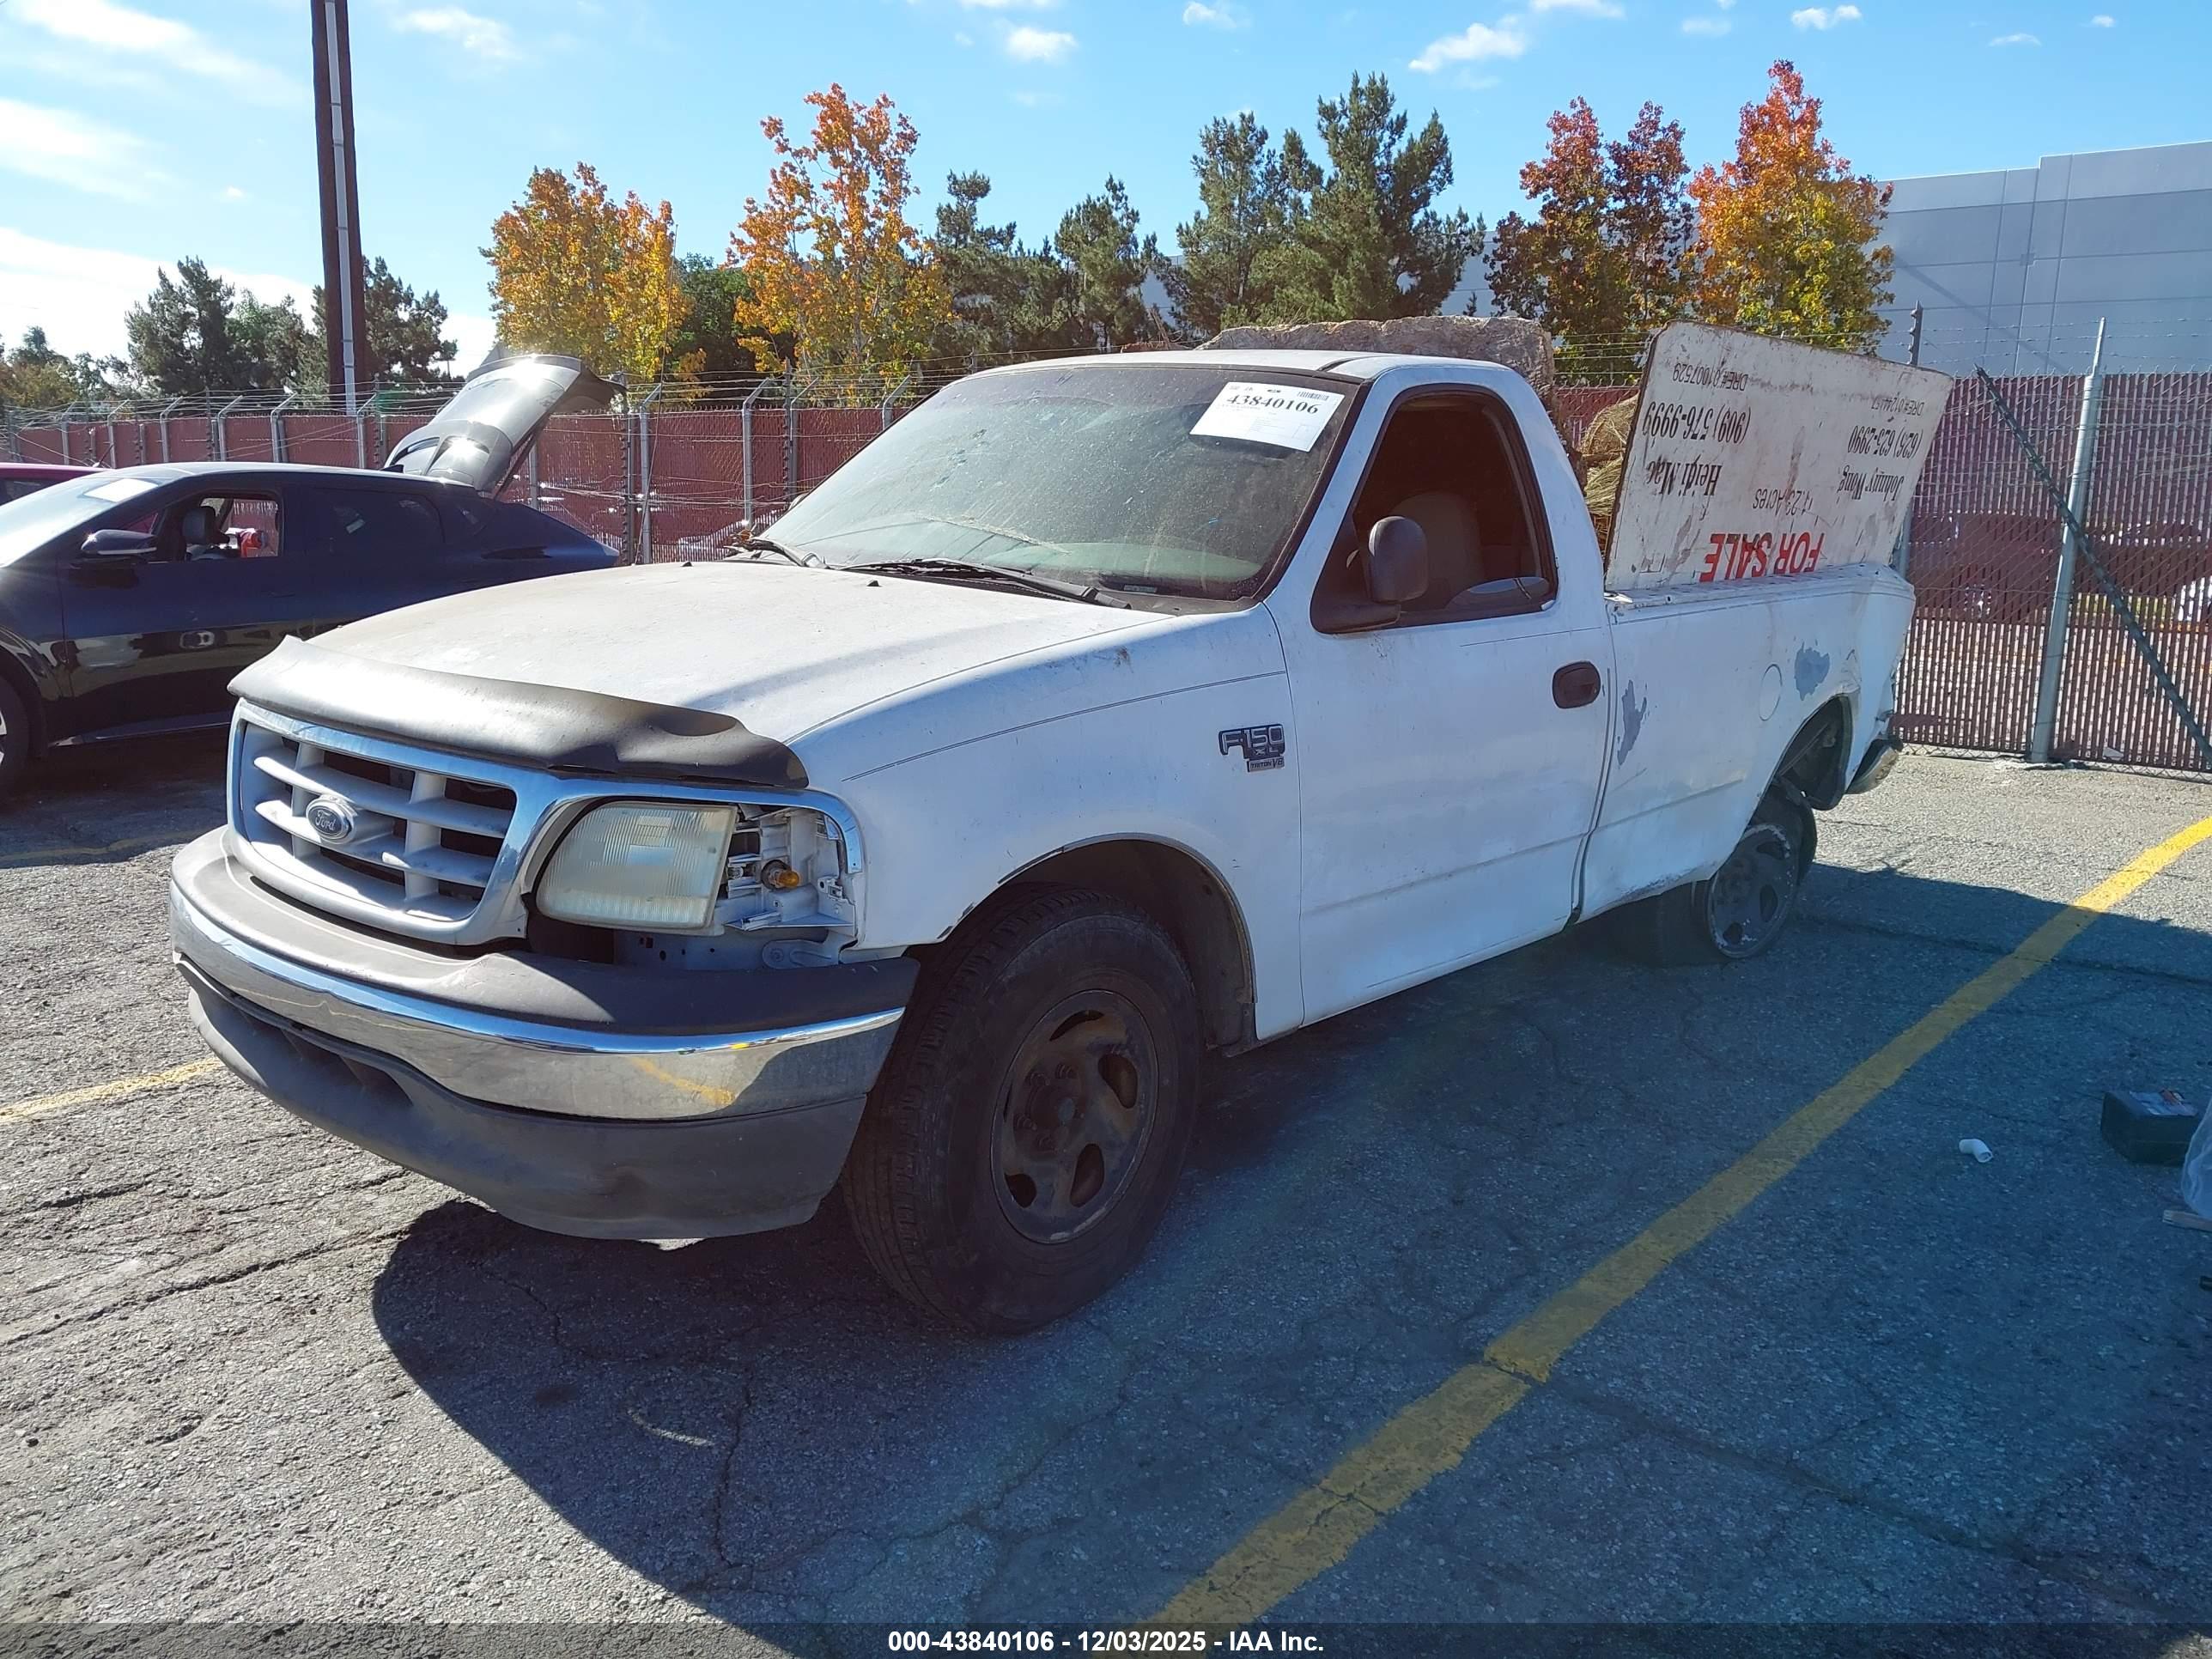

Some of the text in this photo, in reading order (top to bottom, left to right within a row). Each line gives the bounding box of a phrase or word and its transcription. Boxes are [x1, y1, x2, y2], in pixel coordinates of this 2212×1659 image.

[1226, 395, 1322, 414] 43840106
[1642, 401, 1751, 444] (909) 576-9999
[1847, 425, 1896, 456] 625-2990
[1678, 463, 1723, 496] Heidi
[1836, 465, 1905, 502] Johnny Wong
[1753, 489, 1787, 517] Acres
[1698, 531, 1826, 583] FOR SALE
[1250, 757, 1285, 769] TRITON V8
[314, 809, 337, 831] Ford
